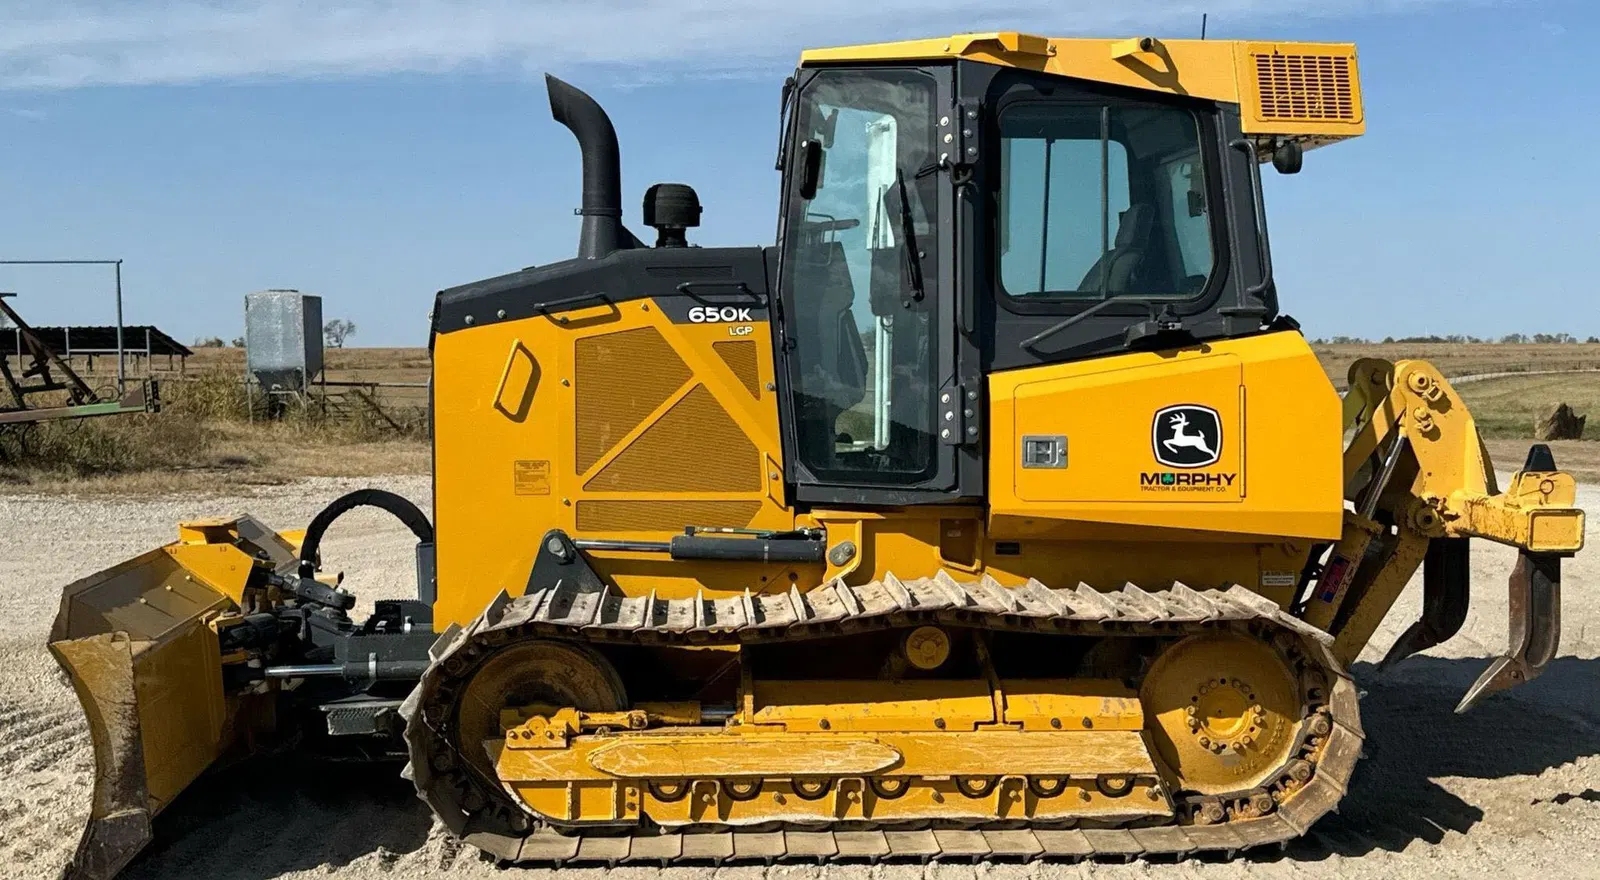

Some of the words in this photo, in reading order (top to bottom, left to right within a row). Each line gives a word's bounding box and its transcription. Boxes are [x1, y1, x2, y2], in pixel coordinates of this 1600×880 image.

[688, 306, 753, 323] 650K
[729, 326, 753, 336] LGP
[1140, 472, 1237, 486] MURPHY
